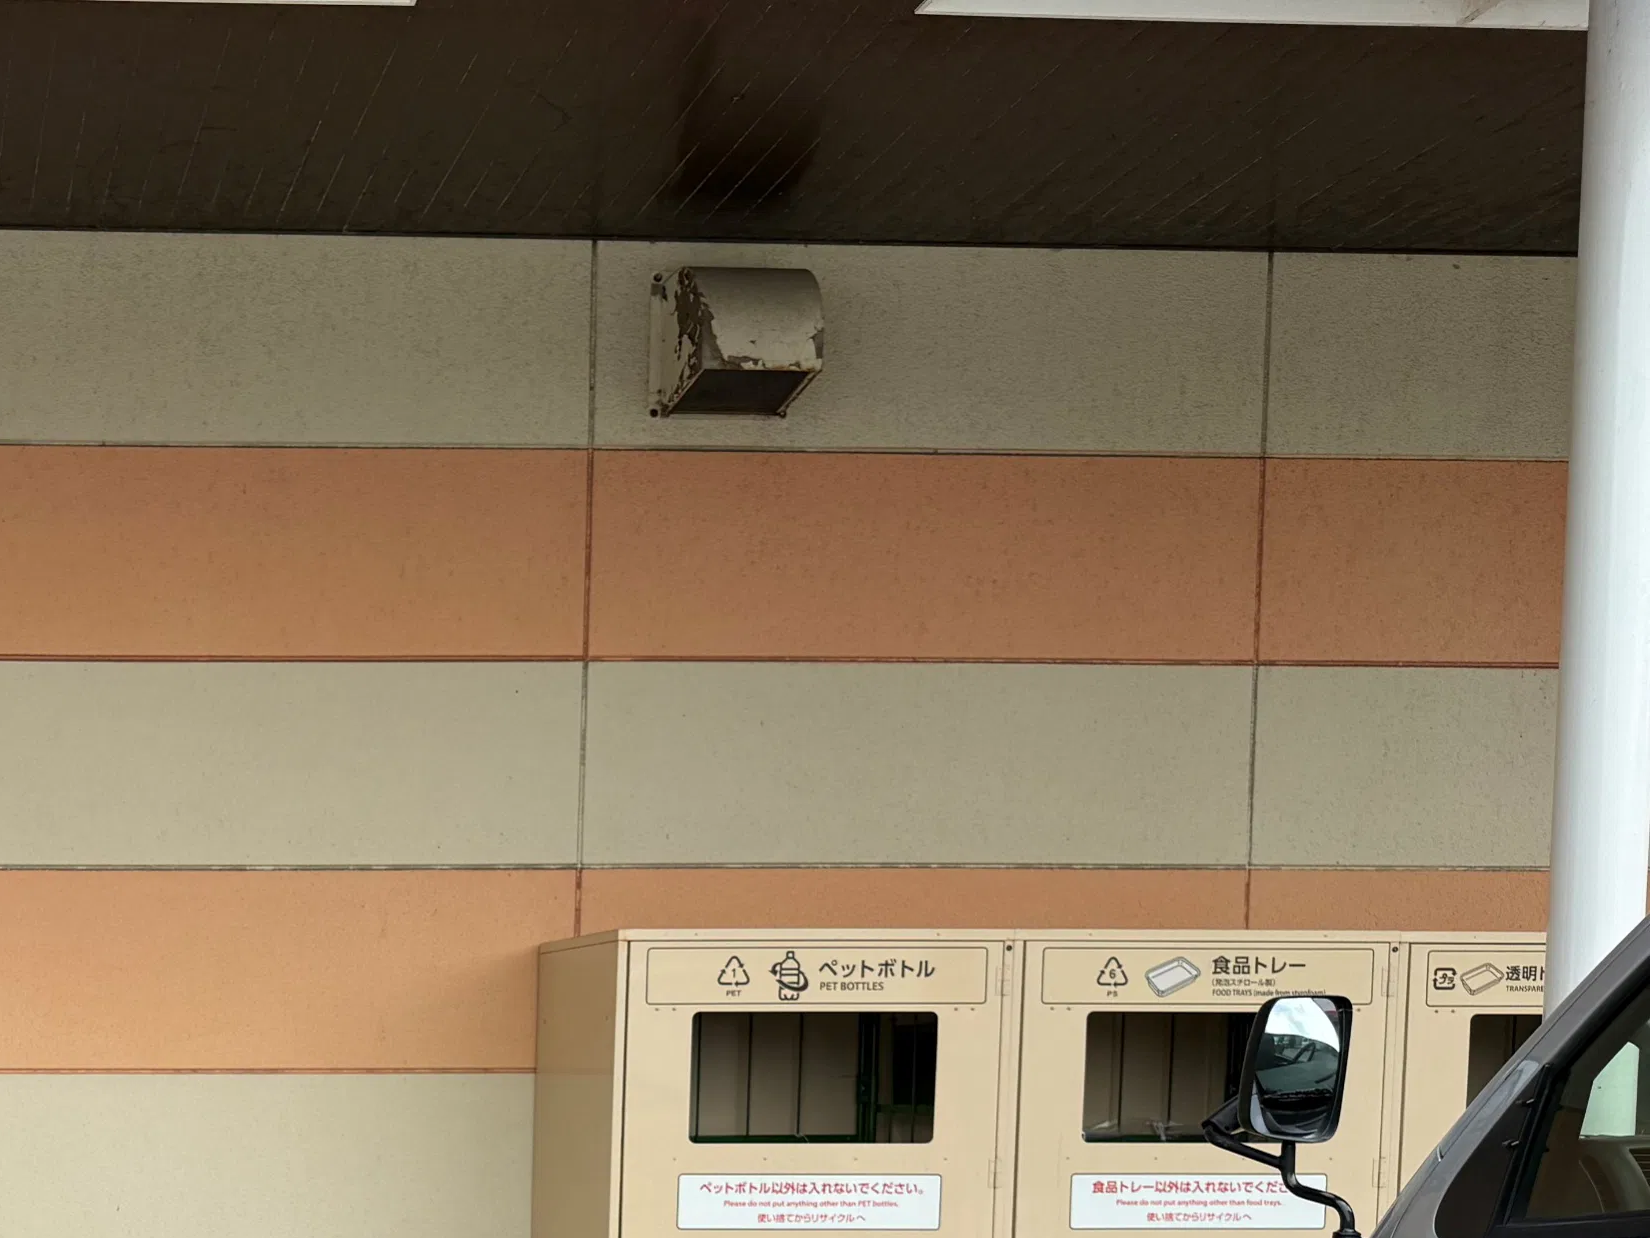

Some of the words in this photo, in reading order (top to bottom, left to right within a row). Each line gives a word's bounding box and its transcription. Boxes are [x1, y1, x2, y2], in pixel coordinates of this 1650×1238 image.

[819, 958, 935, 978] ペットボトル
[1212, 956, 1306, 975] 食品トレー
[820, 982, 838, 991] PET
[841, 982, 884, 991] BOTTLES
[1233, 989, 1252, 997] TRAYS
[700, 1182, 924, 1195] ペットボトル以外は入れないでください。
[772, 1200, 784, 1208] put
[786, 1200, 818, 1208] anything
[1163, 1199, 1175, 1207] put
[1177, 1199, 1207, 1207] anything
